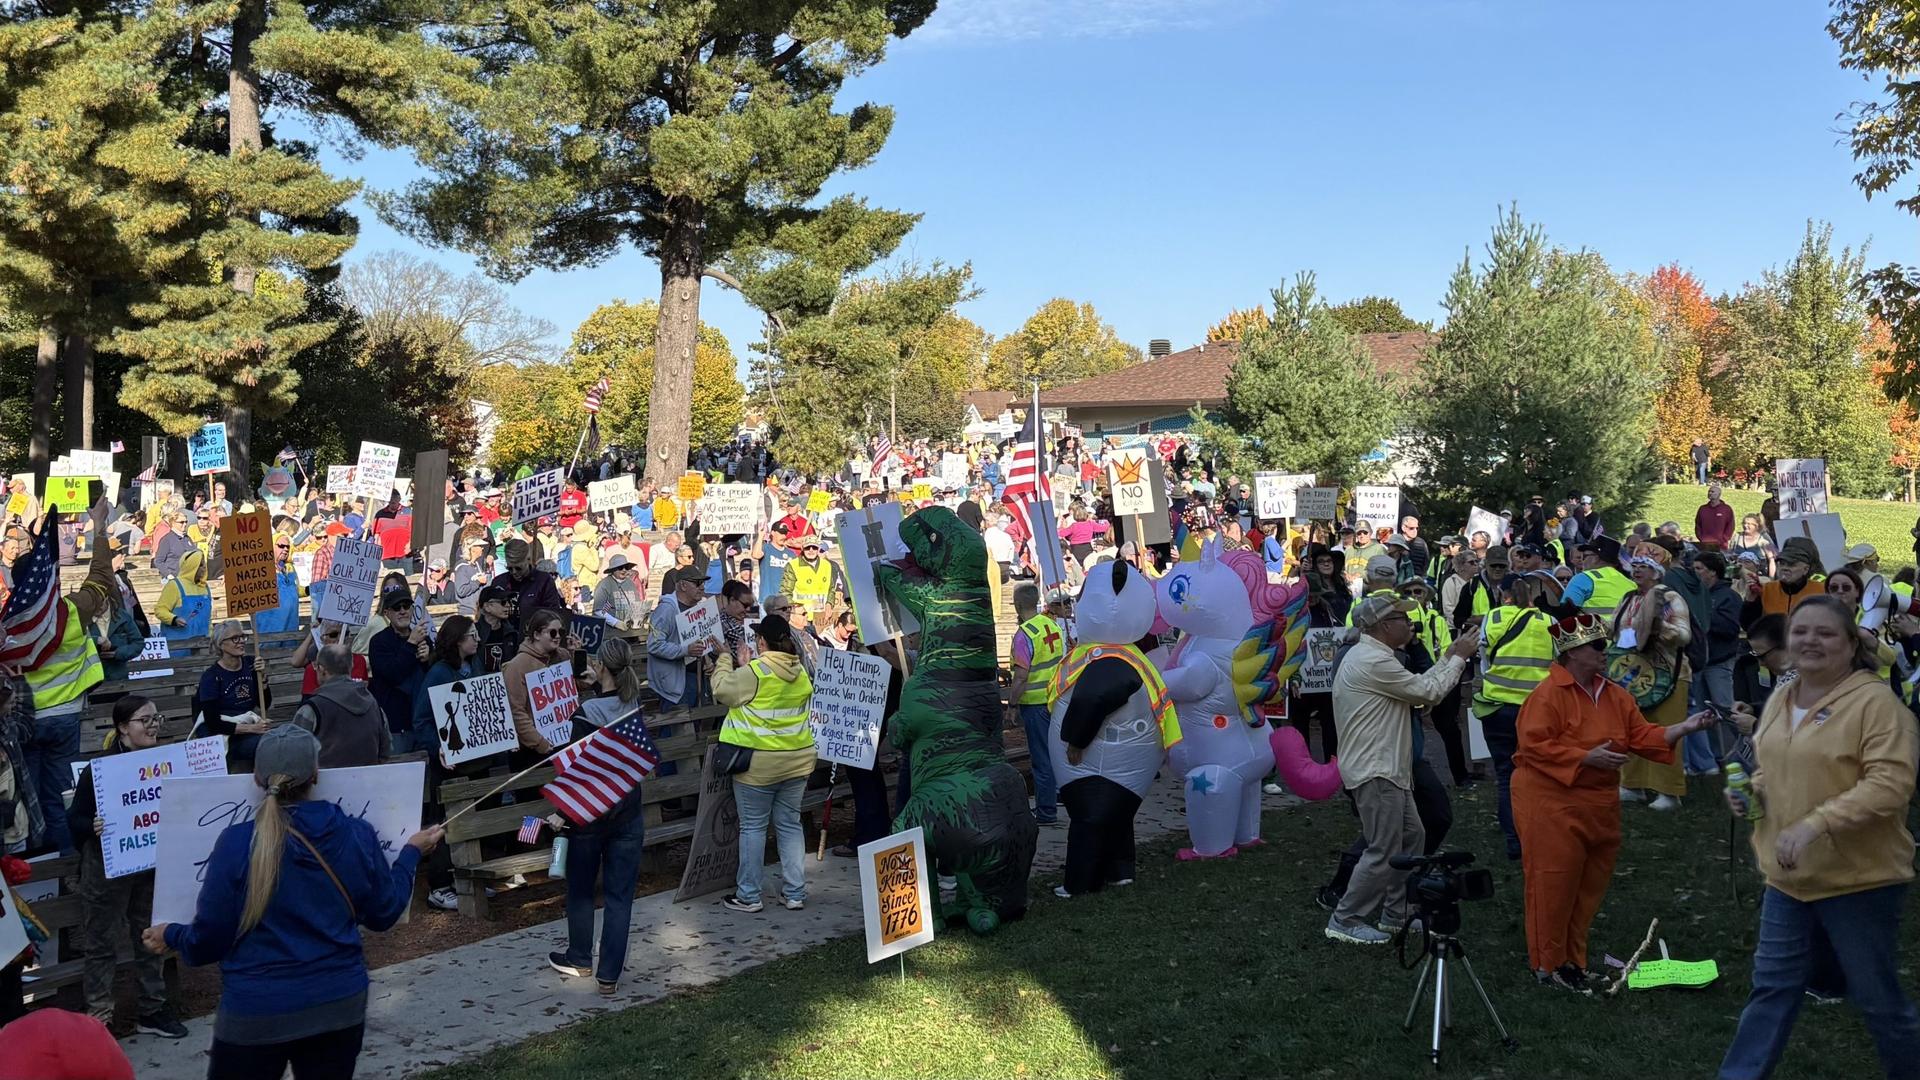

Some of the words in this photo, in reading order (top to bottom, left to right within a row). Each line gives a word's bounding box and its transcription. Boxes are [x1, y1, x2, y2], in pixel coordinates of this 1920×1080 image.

[193, 446, 225, 457] America
[193, 454, 224, 470] Forward
[64, 478, 80, 488] We
[516, 472, 556, 494] SINCE
[536, 485, 560, 499] NO
[604, 482, 619, 493] NO
[704, 486, 714, 497] WE
[1122, 486, 1143, 499] NO
[518, 496, 560, 520] KINGS
[704, 502, 716, 513] NO
[1800, 497, 1816, 512] USA
[236, 518, 259, 535] NO
[718, 522, 730, 532] NO
[231, 538, 264, 552] KINGS
[339, 538, 360, 556] THIS
[224, 550, 274, 568] DICTATORS
[356, 558, 364, 568] IS
[236, 566, 268, 582] NAZIS
[333, 564, 354, 579] OUR
[330, 584, 342, 596] NO
[230, 594, 278, 614] FASCISTS
[144, 641, 166, 650] OFF
[824, 650, 845, 673] Hey
[849, 653, 881, 676] Trump,
[1304, 667, 1325, 677] When
[538, 672, 546, 684] IF
[552, 666, 564, 678] WE
[817, 669, 832, 682] Ron
[838, 672, 877, 690] Johnson
[1303, 679, 1325, 688] Wears
[470, 677, 502, 692] SUPER
[530, 675, 578, 712] BURN
[466, 686, 506, 704] CALLOUS
[814, 685, 840, 698] Derrick
[842, 688, 856, 700] Van
[859, 690, 886, 708] Orden!
[463, 698, 506, 717] FRAGILE
[827, 702, 839, 714] not
[842, 706, 870, 721] getting
[468, 710, 506, 727] RACIST
[536, 716, 554, 728] YOU
[810, 710, 829, 724] PAID
[833, 716, 840, 724] to
[844, 718, 855, 728] be
[468, 720, 506, 738] SEXIST
[822, 726, 843, 740] disgust
[846, 731, 856, 742] for
[859, 736, 872, 746] you
[466, 734, 488, 750] NAZI
[490, 728, 514, 744] POTUS
[827, 741, 862, 762] FREE!!
[139, 762, 173, 781] 24601
[706, 780, 718, 794] WE
[119, 832, 157, 854] FALSE
[880, 847, 907, 874] No
[879, 868, 916, 893] Kings
[881, 886, 916, 914] Since
[886, 904, 918, 935] 1776
